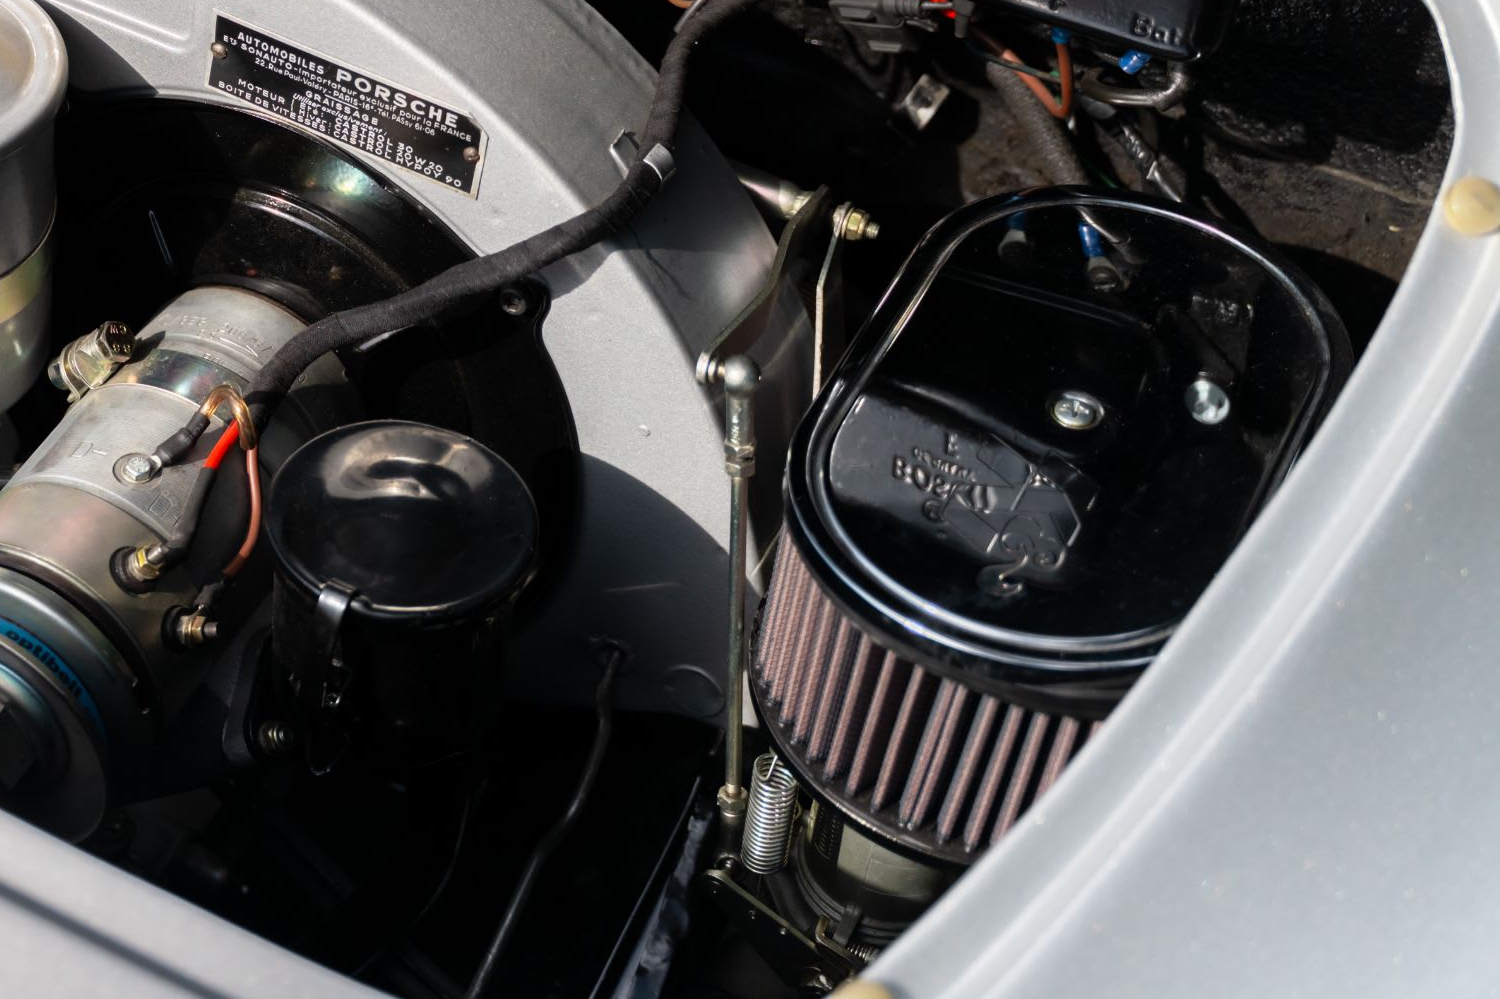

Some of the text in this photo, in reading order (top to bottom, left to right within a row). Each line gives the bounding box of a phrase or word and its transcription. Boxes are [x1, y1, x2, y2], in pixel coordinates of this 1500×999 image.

[237, 30, 459, 130] AUTOMOBILES PORSCHE
[237, 77, 286, 105] MOTEUR
[292, 91, 321, 110] Utiliser
[305, 88, 378, 127] GRAISSAGE
[359, 90, 397, 114] exclusif
[398, 108, 421, 124] pour
[422, 117, 432, 127] la
[433, 119, 472, 143] FRANCE
[218, 79, 252, 101] BOITE
[254, 95, 269, 109] DE
[332, 128, 392, 161] CASTROL
[394, 153, 441, 181] HYPOY
[445, 174, 462, 189] 90
[333, 121, 393, 154] CASTROL
[334, 114, 393, 147] CASTROL
[396, 140, 413, 154] 30
